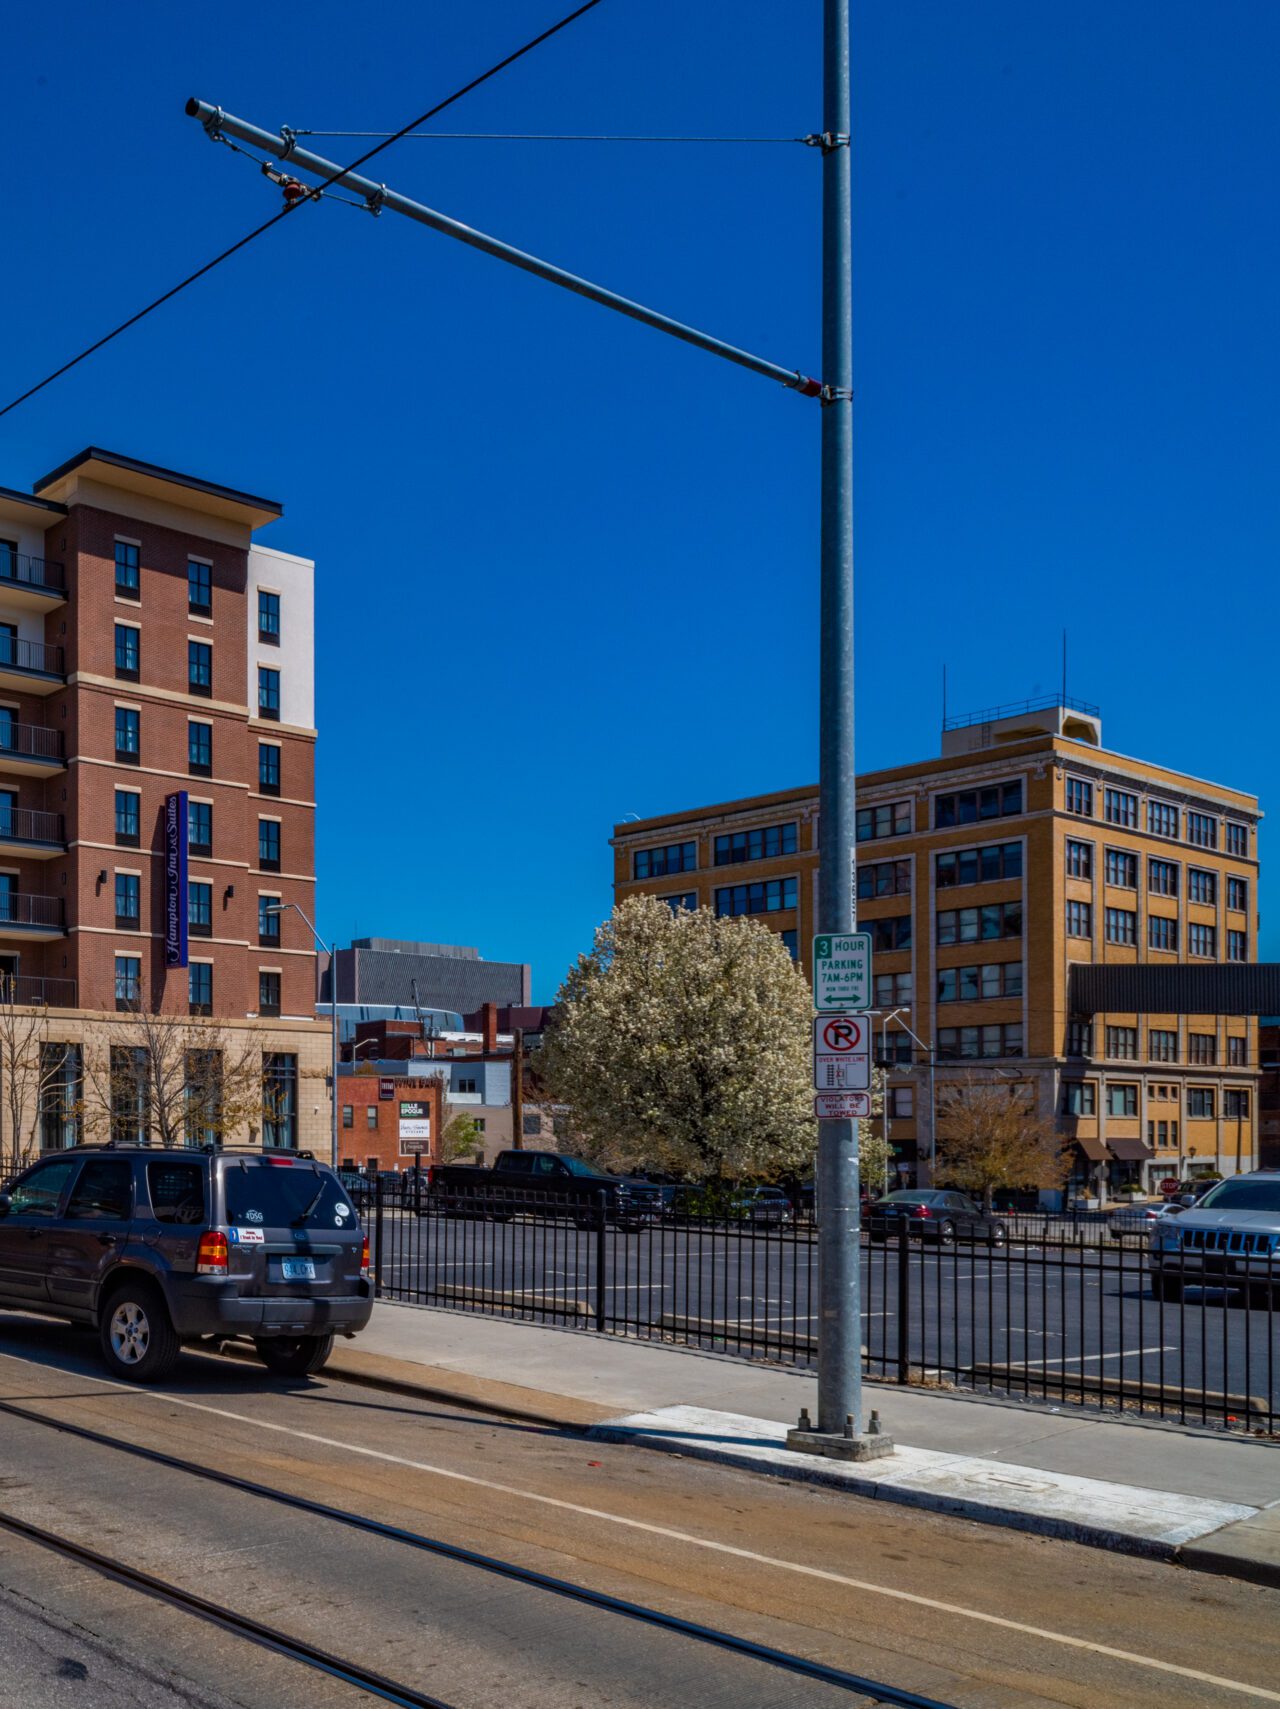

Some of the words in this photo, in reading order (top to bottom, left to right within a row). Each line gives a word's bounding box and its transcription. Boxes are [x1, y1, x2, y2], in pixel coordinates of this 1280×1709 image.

[166, 796, 178, 838] Suites
[167, 846, 179, 884] Inn
[166, 886, 180, 962] Hampton
[819, 940, 829, 956] 3
[835, 941, 865, 952] HOUR
[821, 960, 863, 970] PARKING
[821, 972, 863, 983] 7AM-6PM
